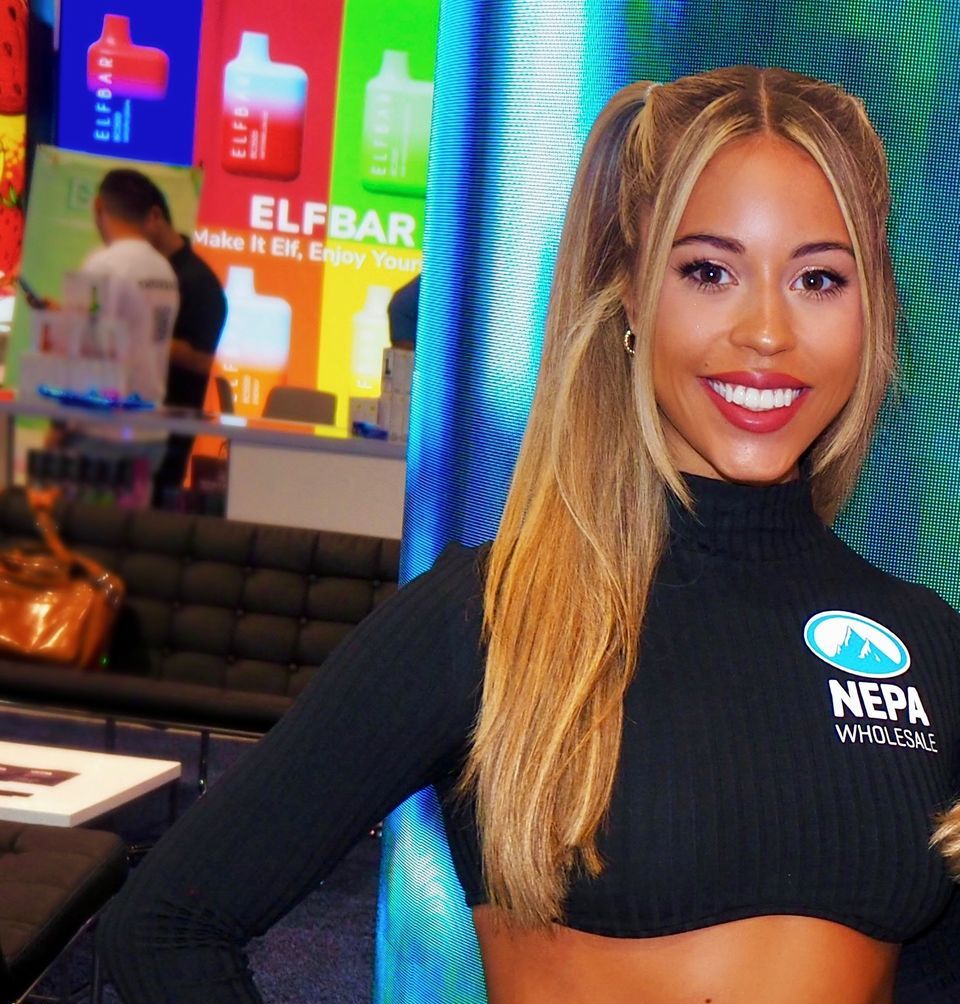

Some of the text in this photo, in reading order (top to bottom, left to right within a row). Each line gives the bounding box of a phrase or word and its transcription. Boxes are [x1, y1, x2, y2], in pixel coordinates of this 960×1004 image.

[95, 56, 113, 141] ELFBAR
[231, 76, 249, 159] ELFB
[249, 194, 417, 248] ELFBAR
[194, 229, 424, 273] Make It Elf, Enjoy Your
[828, 679, 930, 726] NEPA
[835, 724, 938, 753] WHOLESALE
